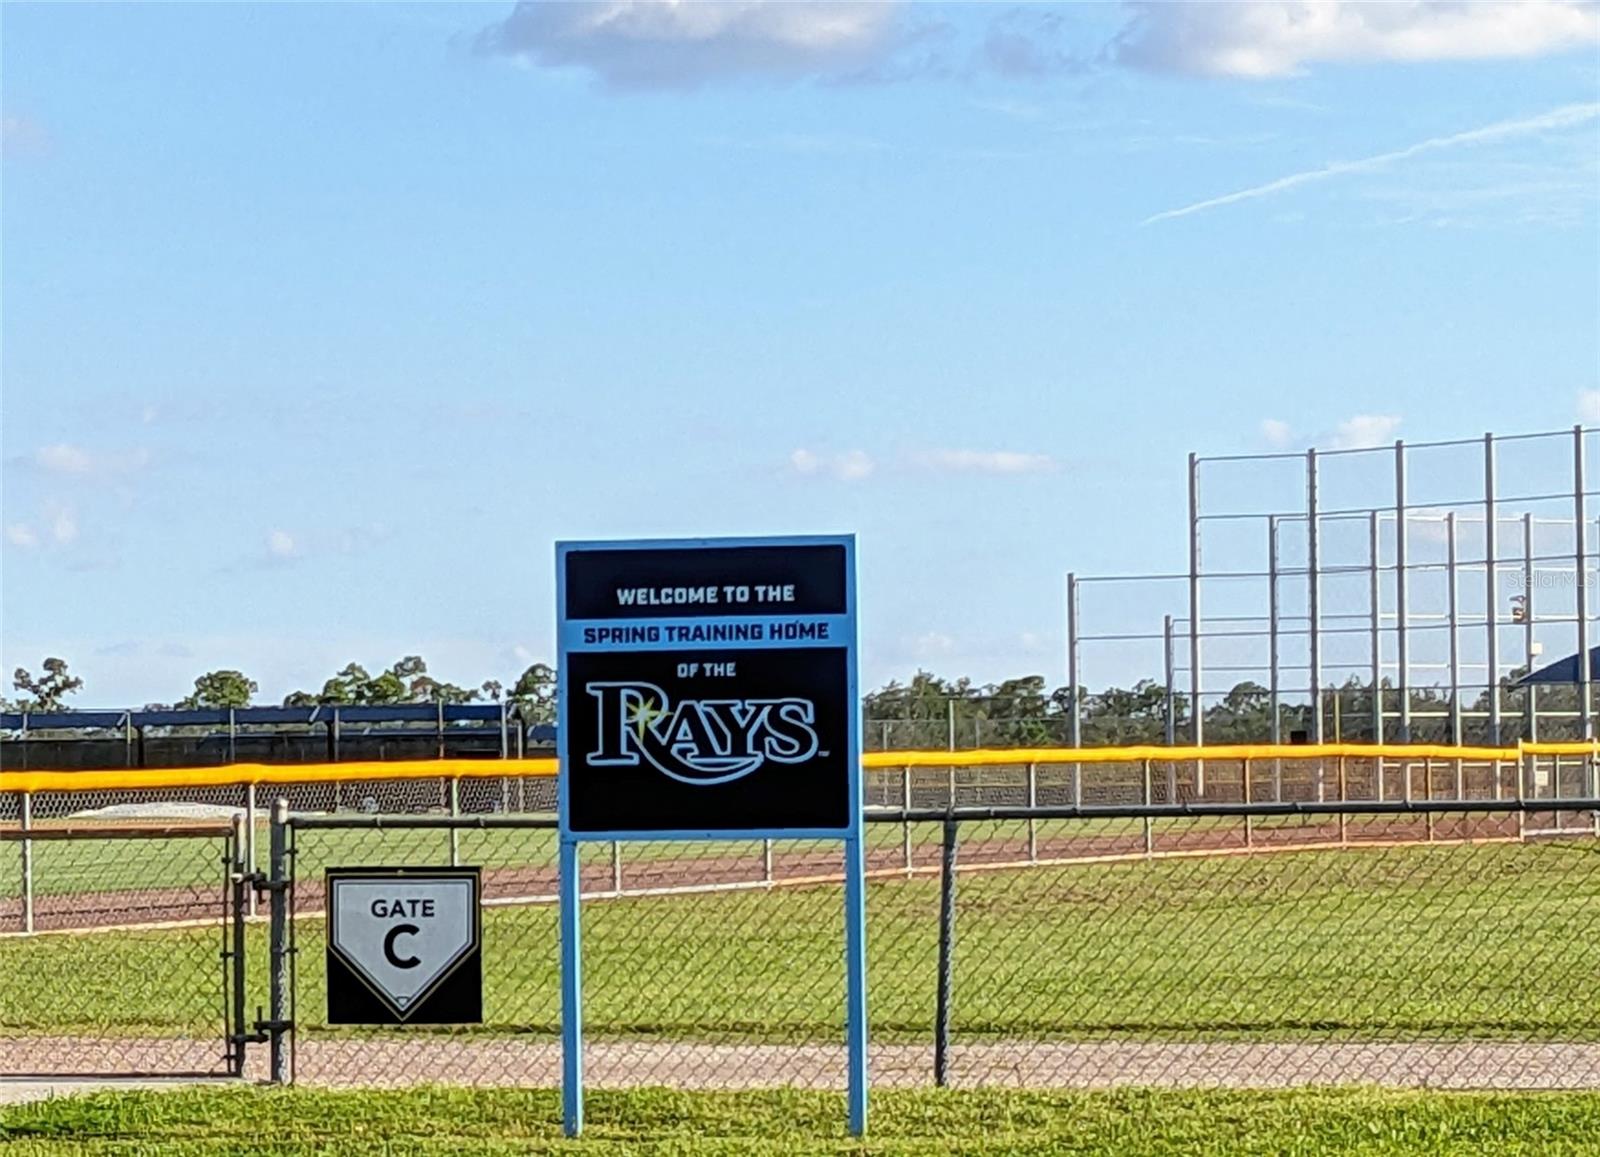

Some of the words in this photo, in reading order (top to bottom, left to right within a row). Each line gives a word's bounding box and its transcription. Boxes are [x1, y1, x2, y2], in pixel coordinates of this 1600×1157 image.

[616, 586, 718, 606] WELCOME
[723, 585, 750, 603] TO
[754, 584, 795, 602] THE
[583, 626, 660, 645] SPRING
[665, 623, 763, 642] TRAINING
[769, 622, 829, 640] HOME
[677, 663, 699, 678] OF
[703, 662, 736, 677] THE
[585, 681, 819, 785] RAYS
[371, 899, 435, 918] GATE
[383, 923, 422, 970] C
